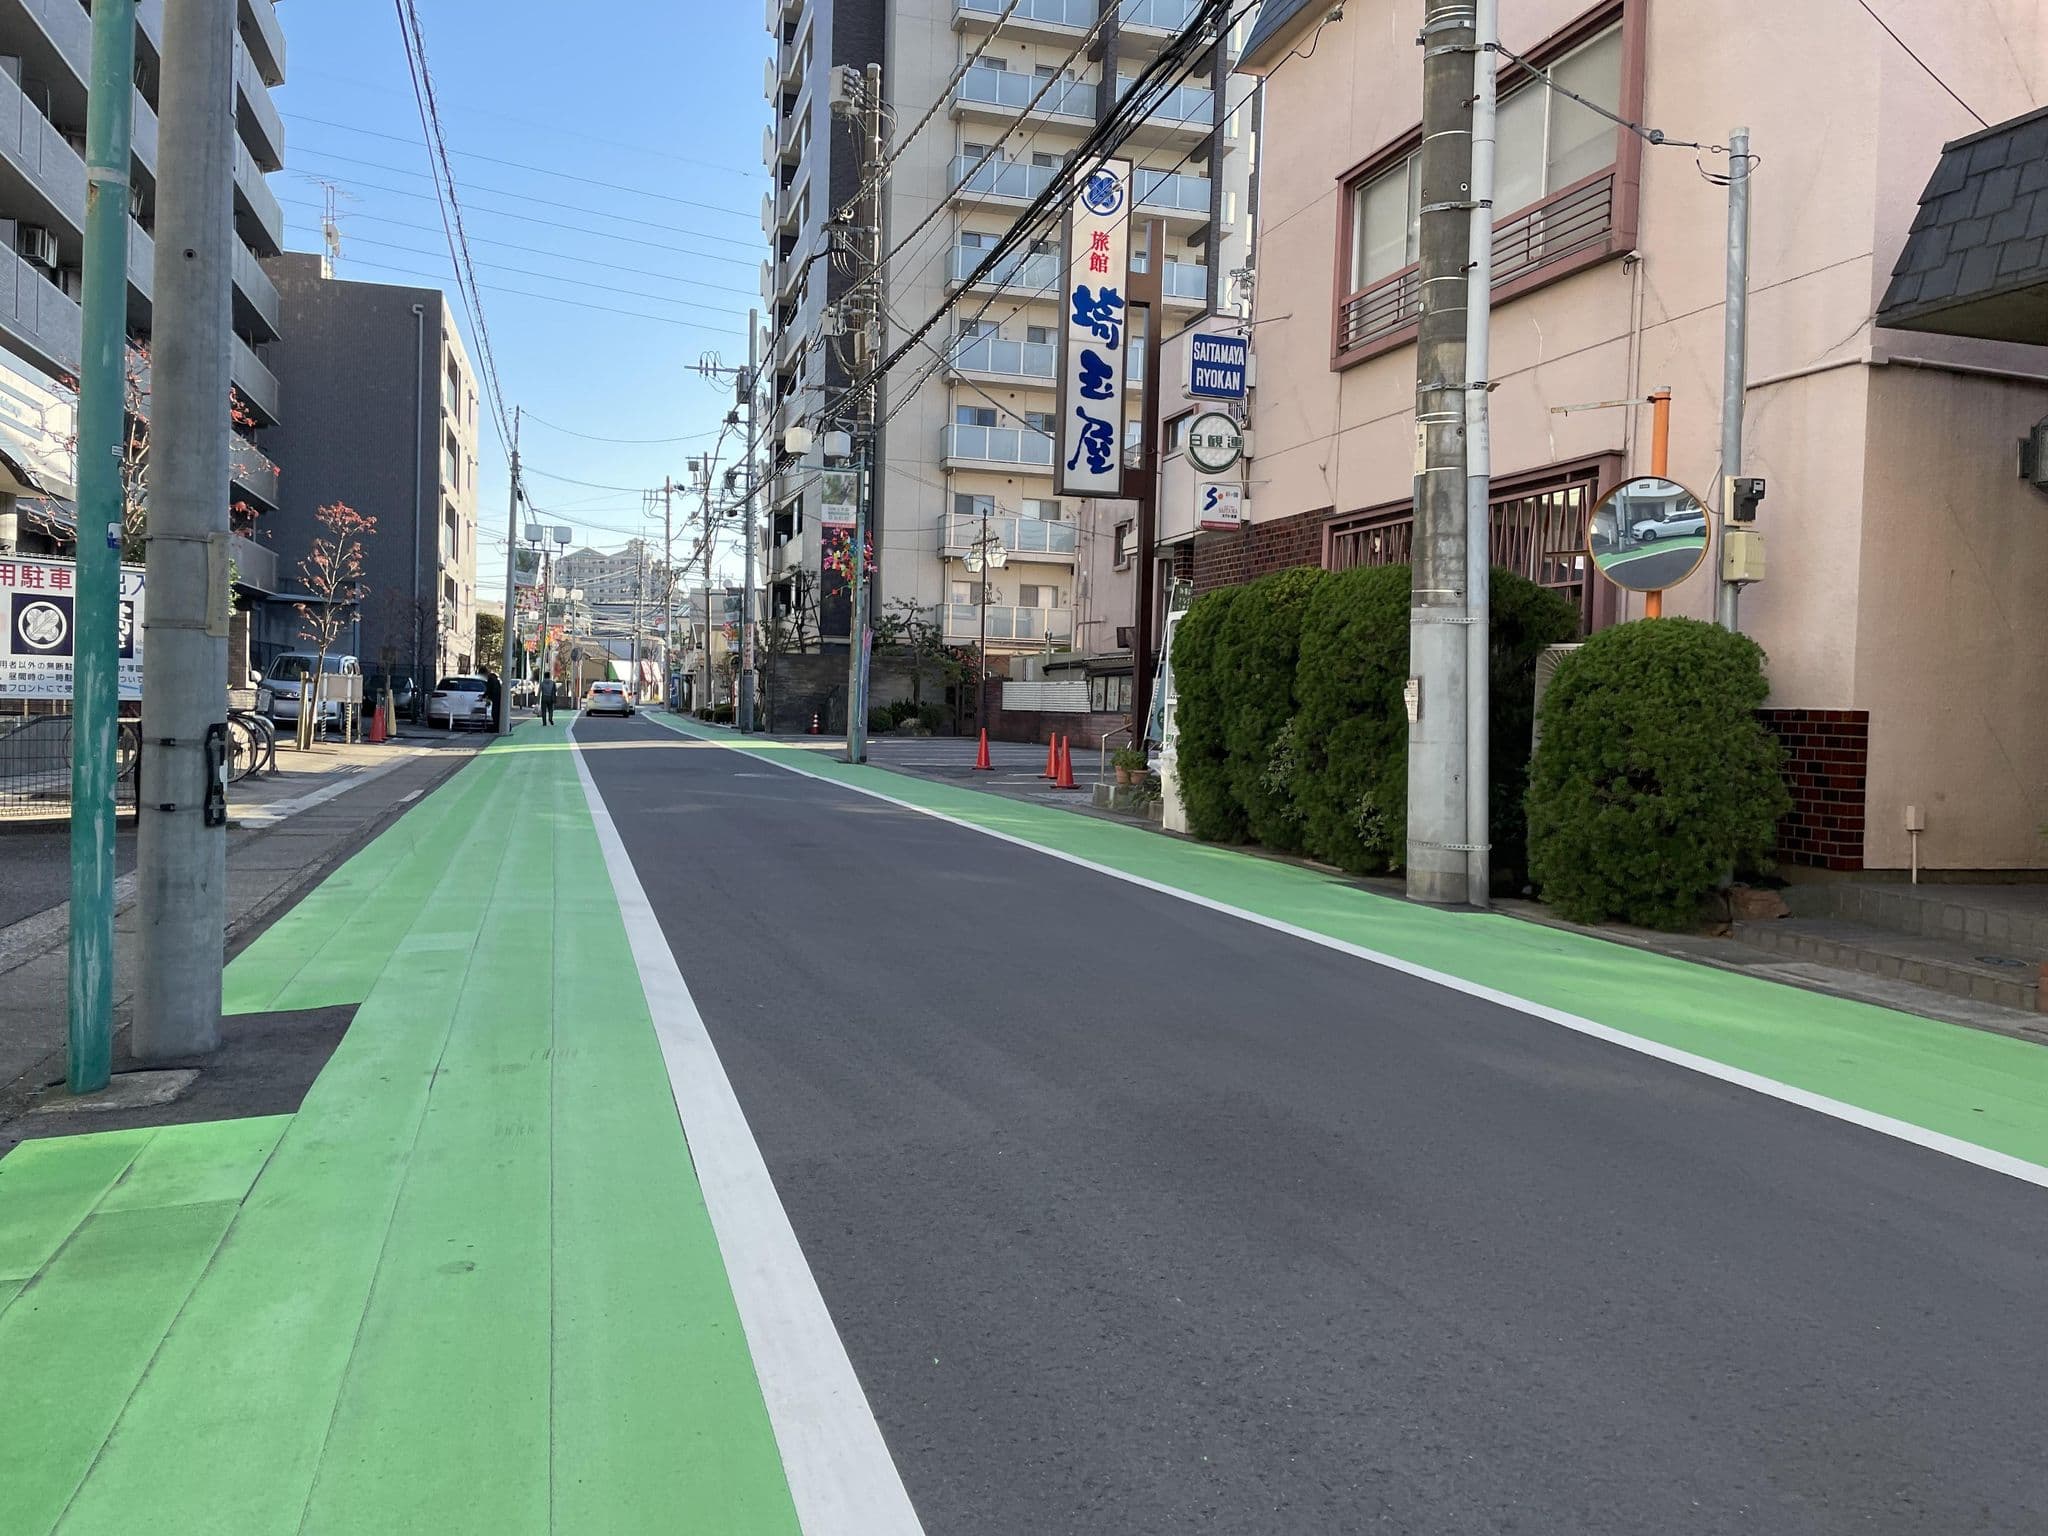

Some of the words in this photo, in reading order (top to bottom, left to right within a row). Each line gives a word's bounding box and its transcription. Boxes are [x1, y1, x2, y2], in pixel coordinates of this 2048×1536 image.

[1089, 230, 1111, 274] 旅館
[1193, 341, 1245, 366] SAITAMAYA
[1067, 284, 1125, 475] 埼玉屋
[1196, 367, 1241, 391] RYOKAN
